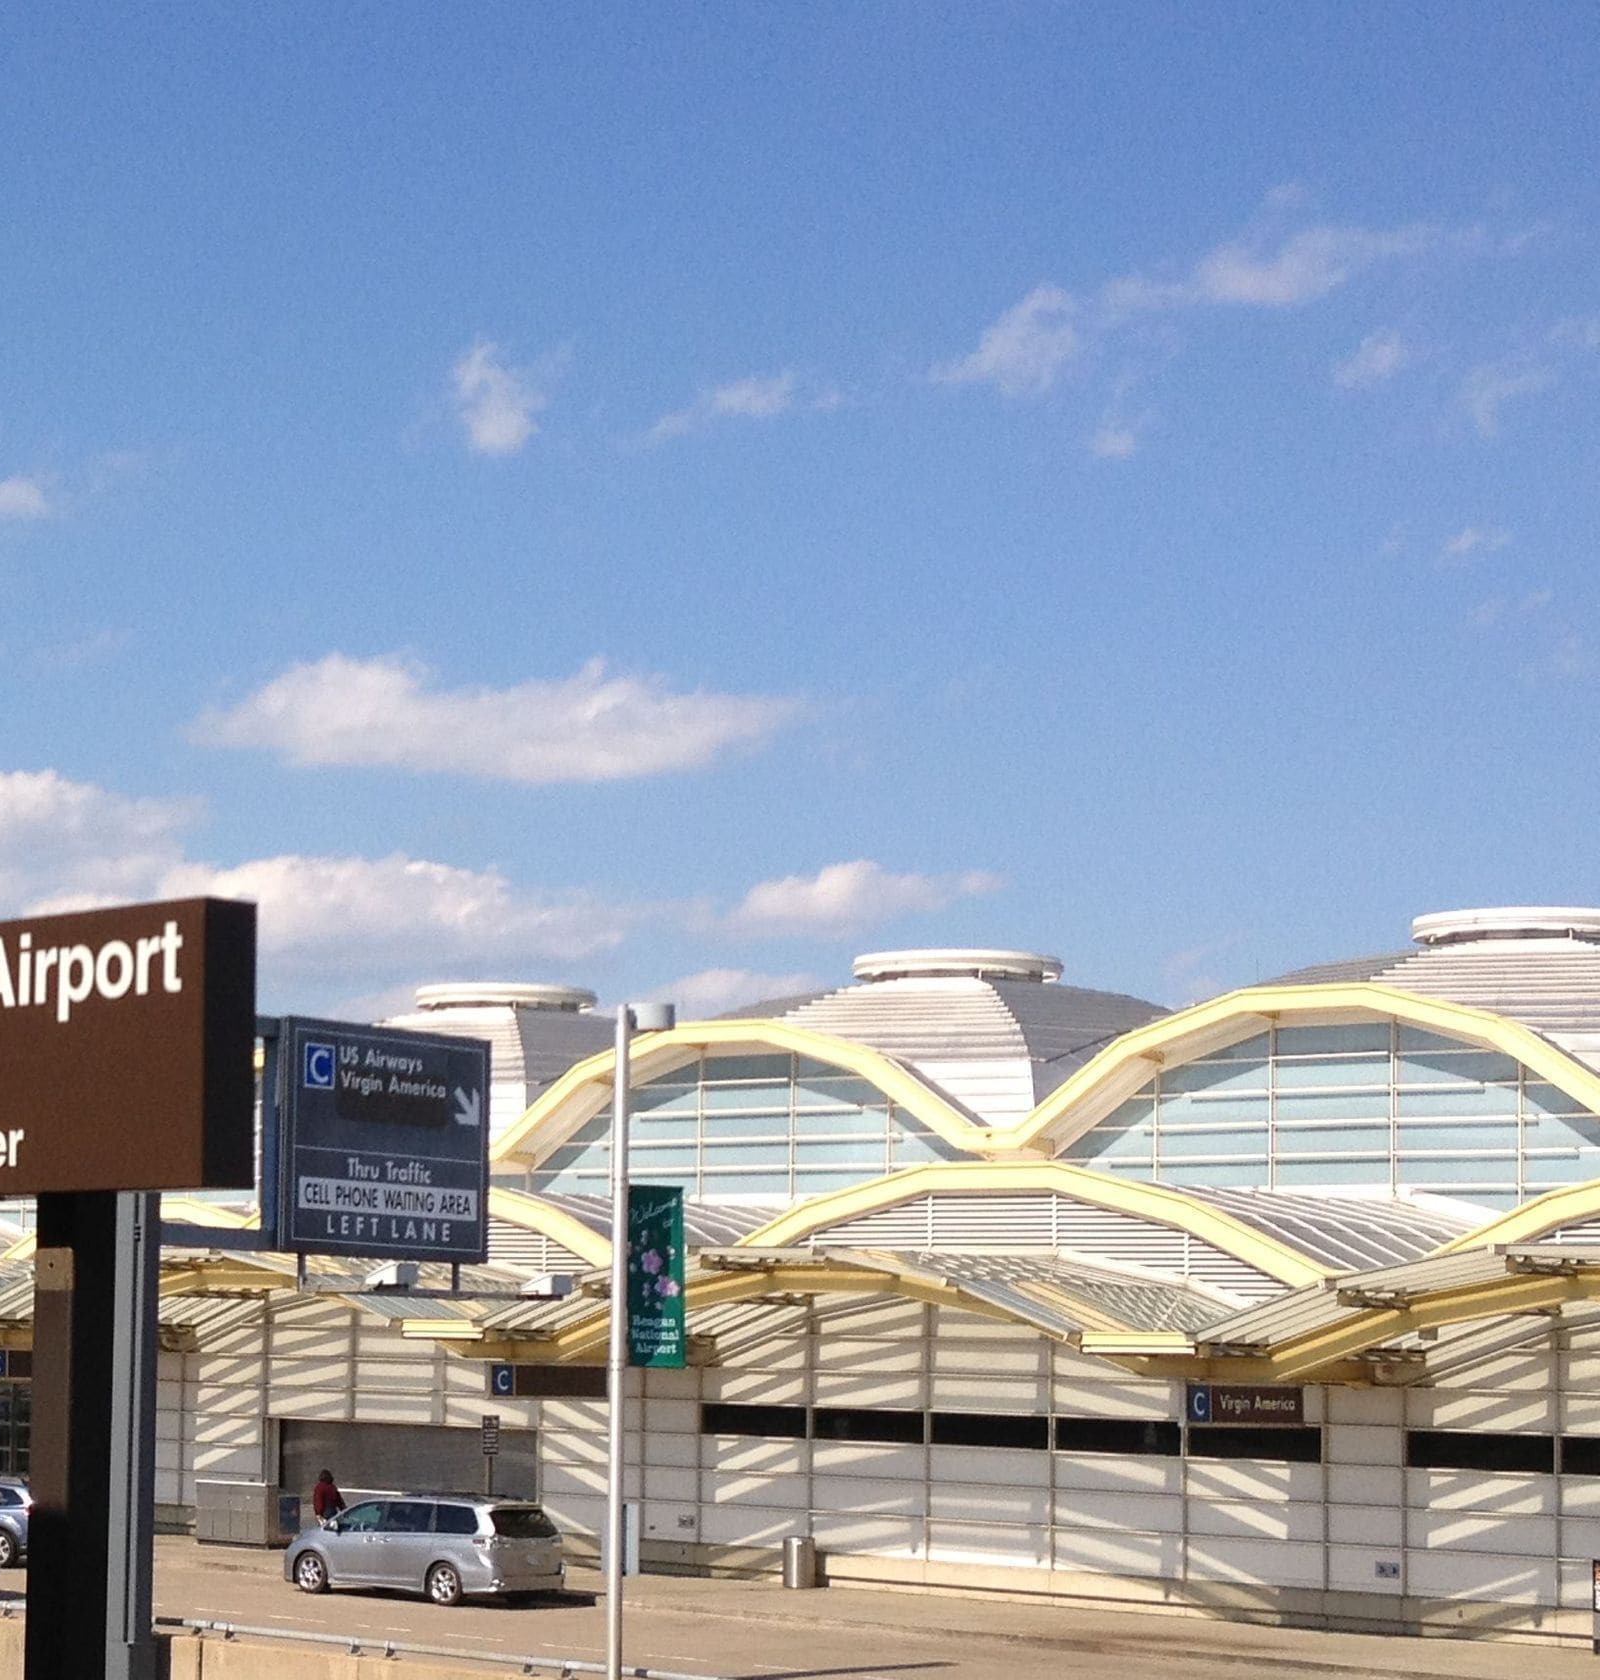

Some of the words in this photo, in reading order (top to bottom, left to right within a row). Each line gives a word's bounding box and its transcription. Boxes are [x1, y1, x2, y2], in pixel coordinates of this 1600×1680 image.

[309, 1049, 330, 1084] C
[340, 1045, 359, 1065] US
[365, 1048, 424, 1073] Airways
[340, 1070, 384, 1096] Virgin
[388, 1074, 447, 1099] America
[347, 1157, 380, 1180] Thru
[385, 1161, 432, 1184] Traffic
[304, 1182, 331, 1206] CELL
[335, 1185, 379, 1209] PHONE
[383, 1189, 436, 1213] WAITING
[438, 1194, 472, 1216] AREA
[326, 1214, 380, 1238] LEFT
[391, 1219, 452, 1243] LANE
[631, 1328, 680, 1341] National
[632, 1314, 676, 1329] Reagan
[635, 1341, 677, 1356] Airport
[496, 1369, 509, 1391] C
[1193, 1391, 1206, 1416] C
[1220, 1394, 1251, 1415] Virgin
[1253, 1395, 1296, 1411] America
